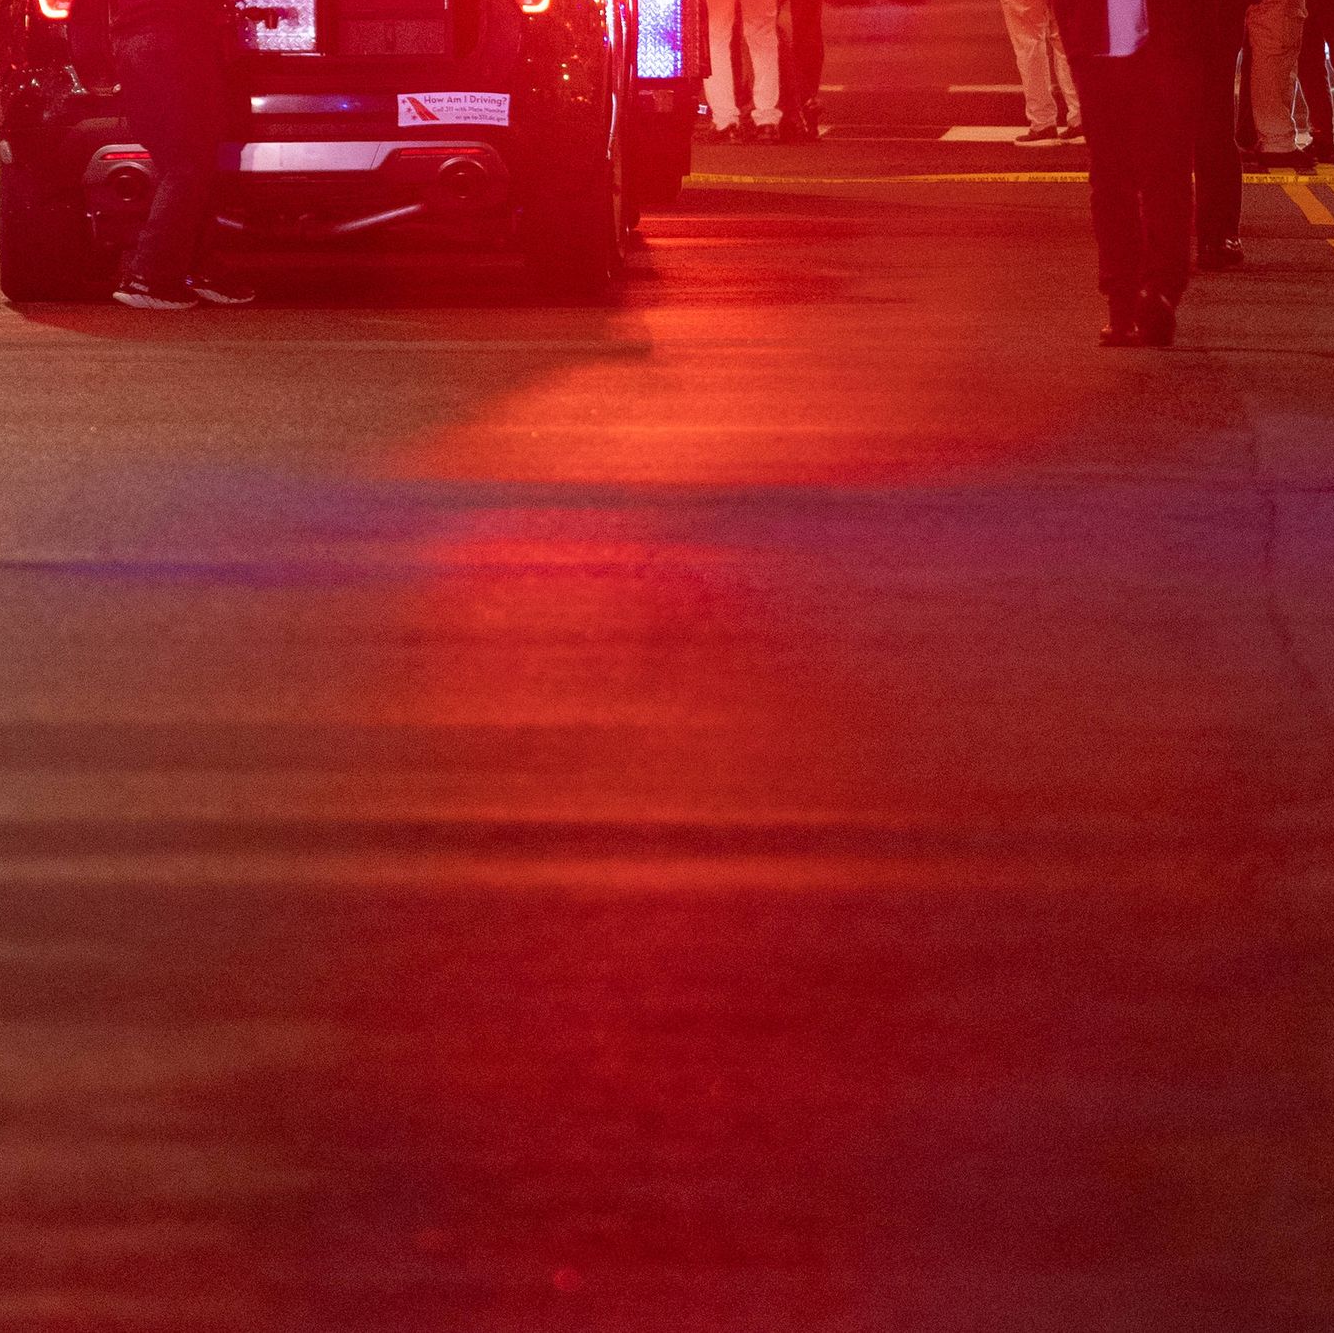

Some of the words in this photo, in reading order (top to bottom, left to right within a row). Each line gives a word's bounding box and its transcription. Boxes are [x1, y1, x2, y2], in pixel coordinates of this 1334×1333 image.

[424, 96, 444, 104] How
[447, 96, 462, 104] Am
[469, 95, 508, 107] Driving?
